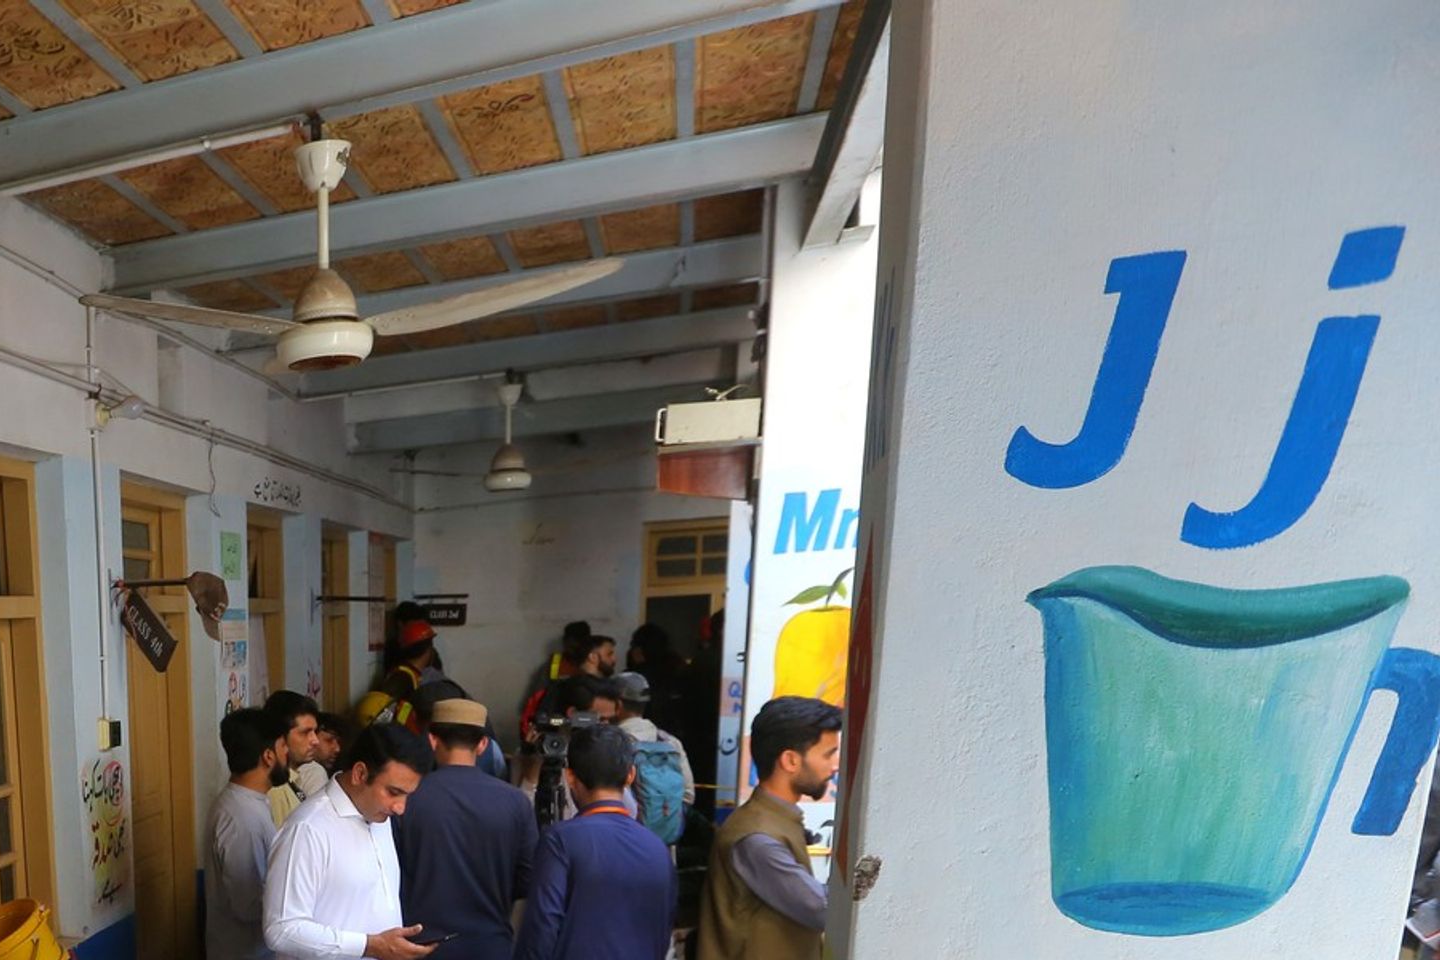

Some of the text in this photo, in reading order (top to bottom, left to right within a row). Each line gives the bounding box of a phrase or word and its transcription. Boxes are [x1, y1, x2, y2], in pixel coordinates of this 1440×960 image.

[1004, 250, 1187, 489] J
[1180, 225, 1407, 550] j
[126, 604, 152, 641] CLASS
